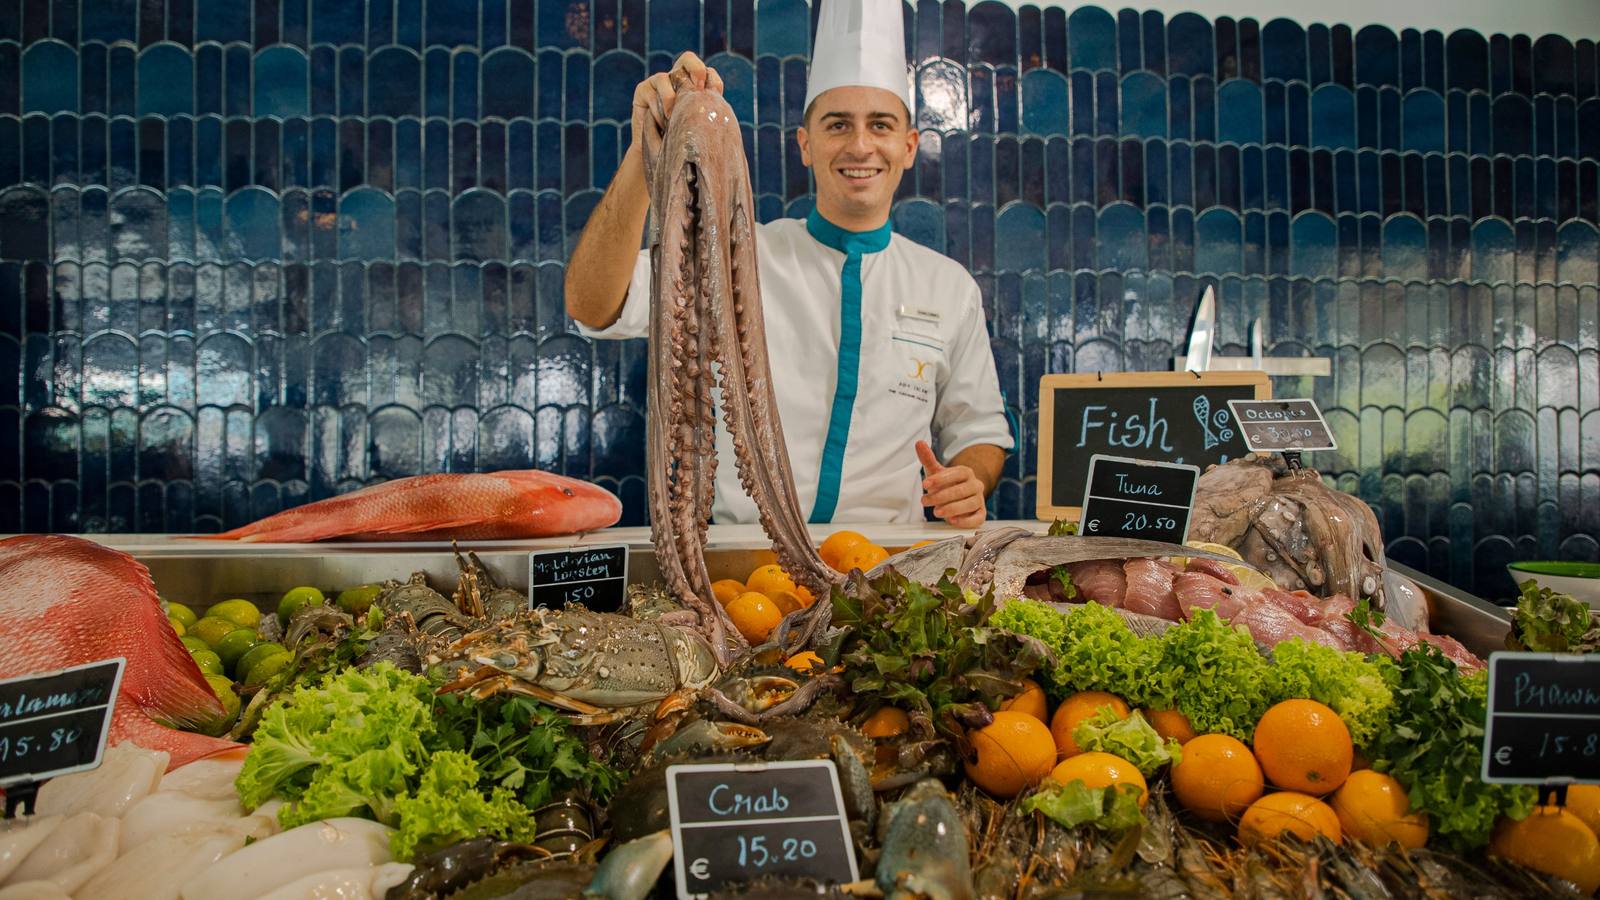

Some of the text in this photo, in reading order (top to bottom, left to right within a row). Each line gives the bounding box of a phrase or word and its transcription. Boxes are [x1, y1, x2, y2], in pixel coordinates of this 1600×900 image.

[1076, 397, 1174, 452] Fish
[1115, 473, 1163, 496] Tuna
[1088, 512, 1176, 532] € 20.50
[1495, 746, 1512, 765] €
[709, 784, 789, 816] Crab
[690, 835, 817, 880] € 15.20
